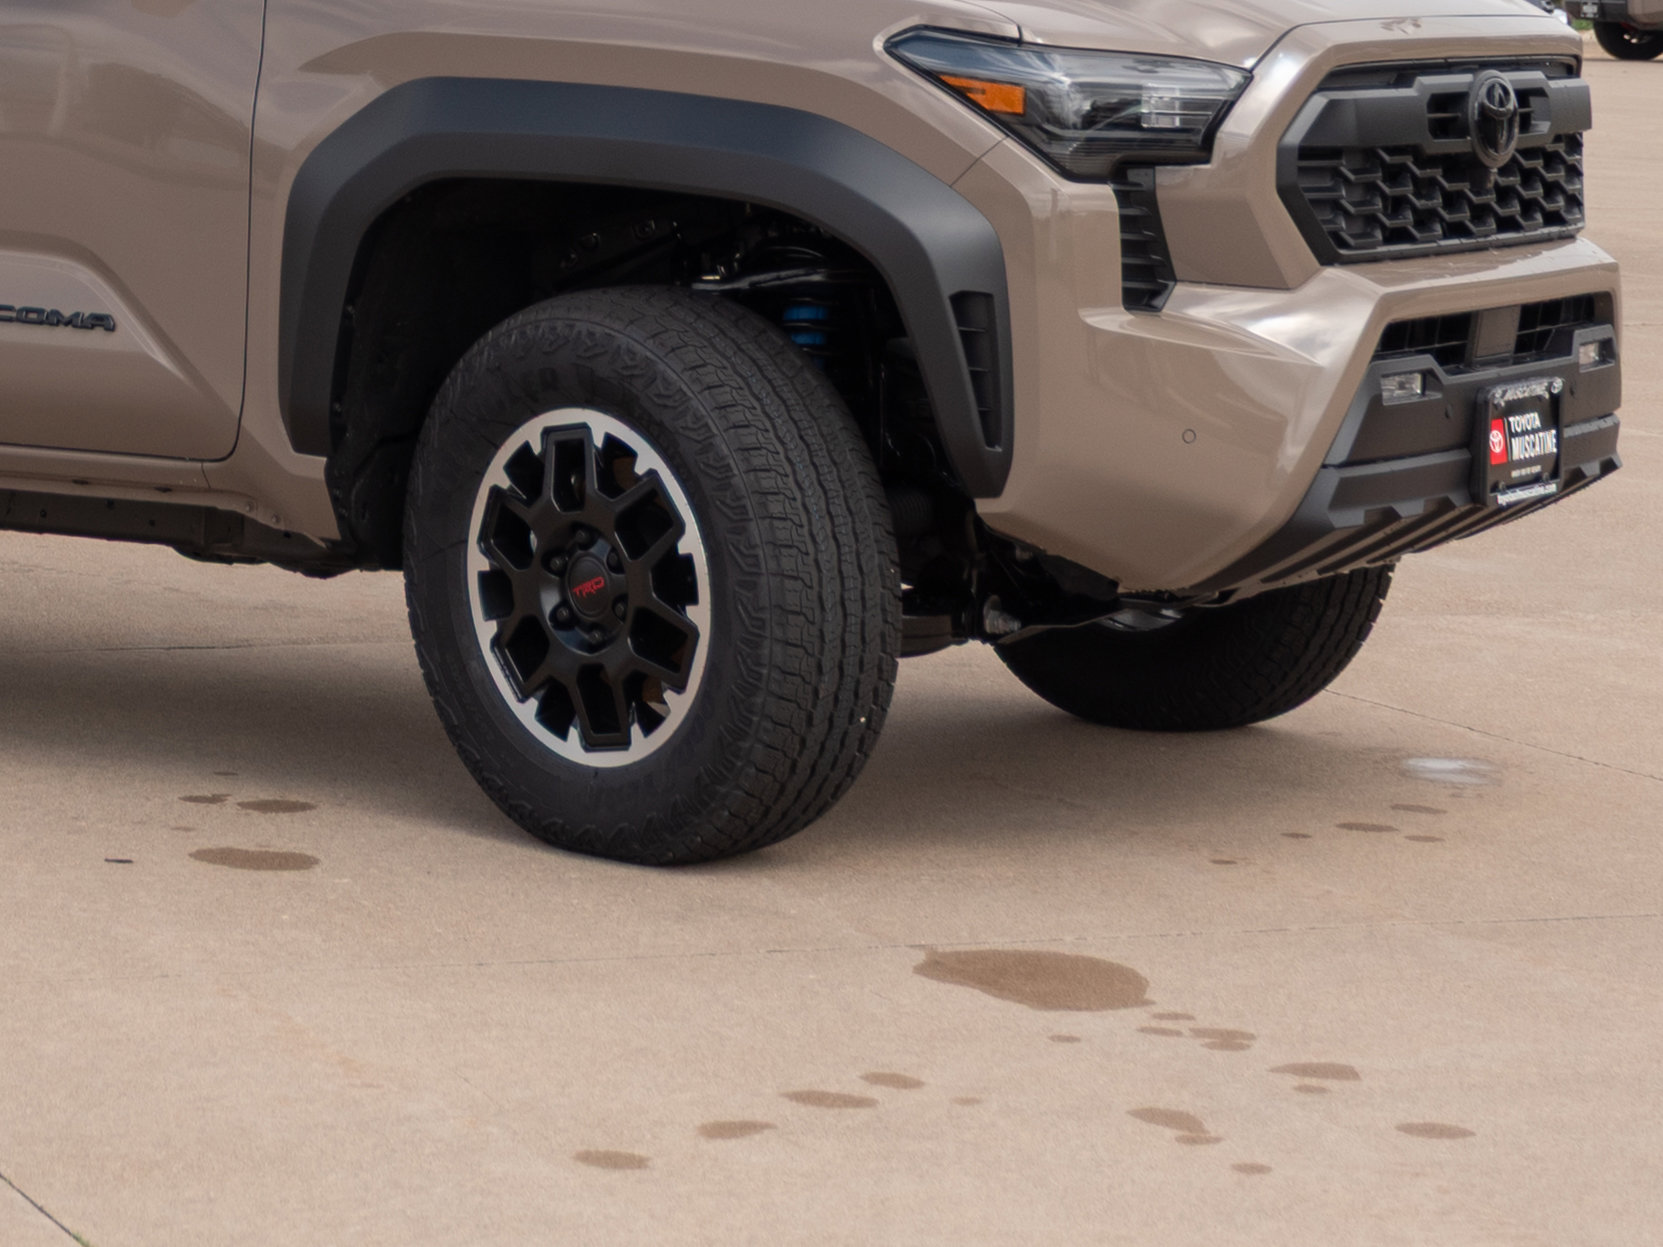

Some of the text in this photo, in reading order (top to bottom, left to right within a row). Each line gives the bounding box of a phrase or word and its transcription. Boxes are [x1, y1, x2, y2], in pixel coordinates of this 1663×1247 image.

[1508, 412, 1541, 433] TOYOTA
[1511, 429, 1557, 461] MUSCATINE
[572, 576, 605, 598] TRD
